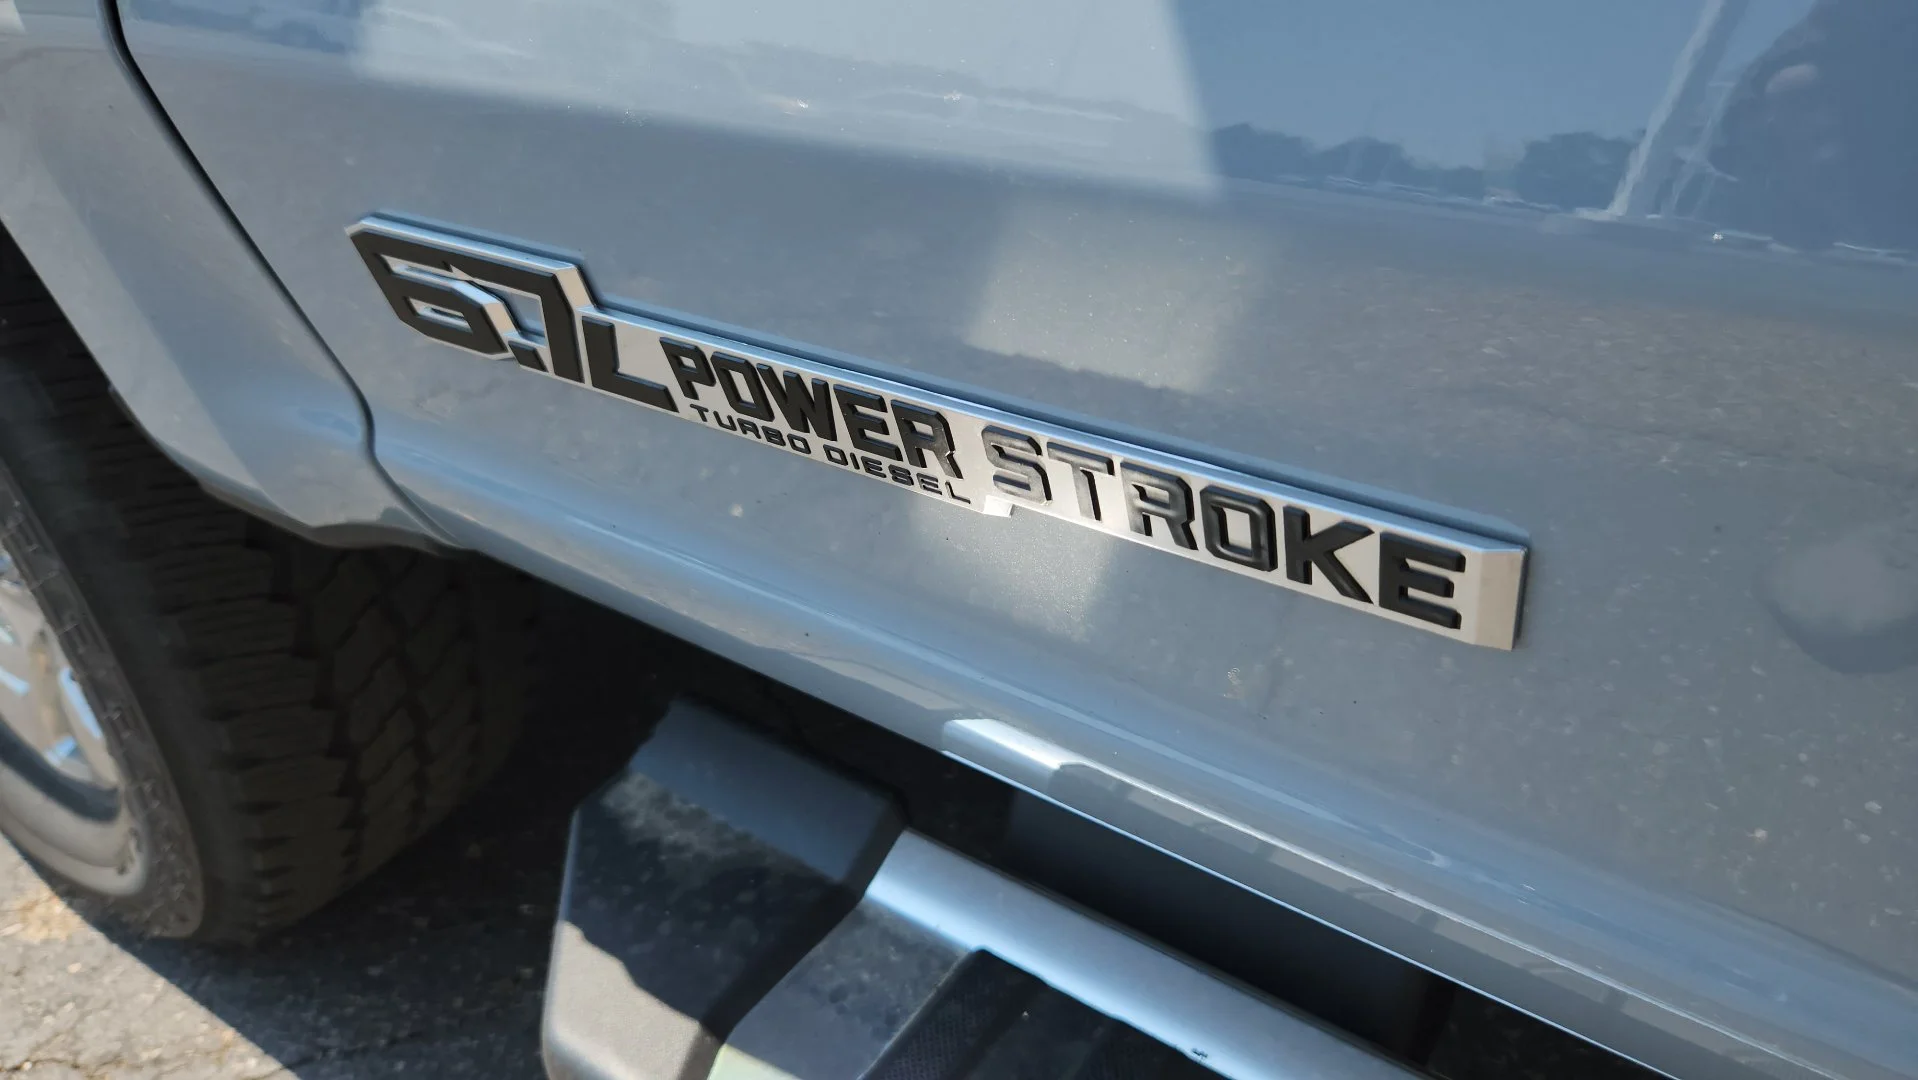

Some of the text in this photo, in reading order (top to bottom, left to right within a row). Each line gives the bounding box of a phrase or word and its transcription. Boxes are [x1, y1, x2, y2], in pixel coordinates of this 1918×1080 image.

[350, 229, 1466, 630] 6.7L POWER STROKE
[689, 404, 971, 504] TURBO DIESEL
